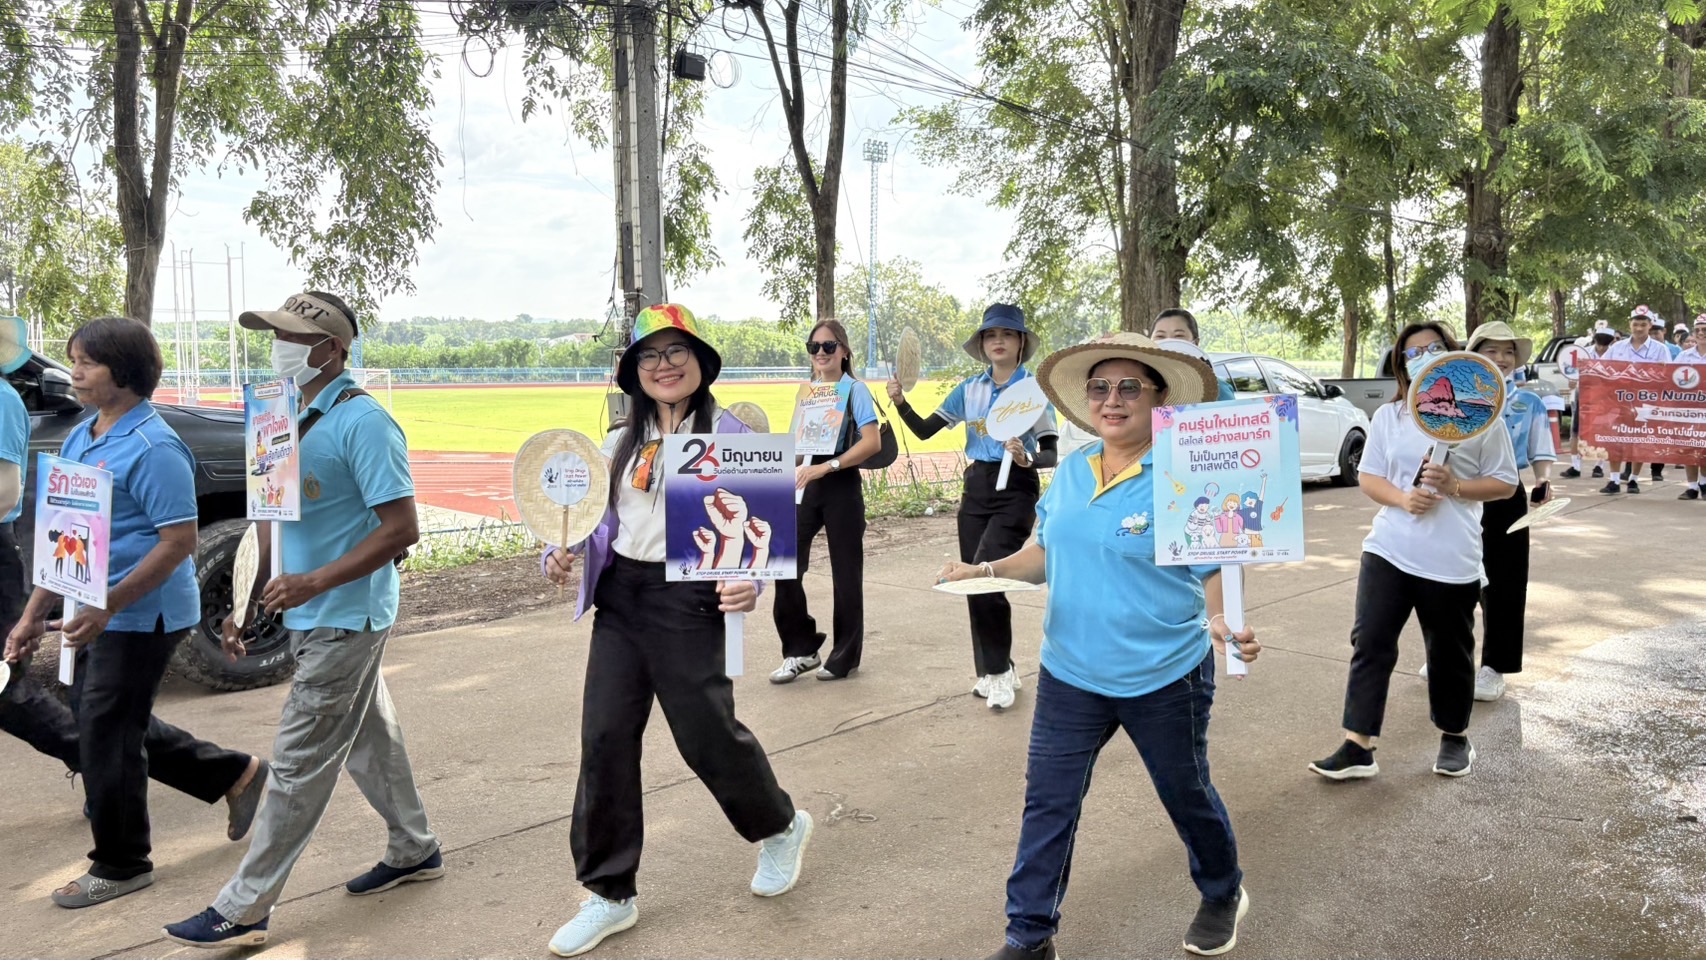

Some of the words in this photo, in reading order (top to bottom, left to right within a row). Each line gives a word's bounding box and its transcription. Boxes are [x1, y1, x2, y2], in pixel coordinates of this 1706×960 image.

[1681, 368, 1690, 382] 1
[1615, 389, 1635, 402] To
[1638, 389, 1658, 401] Be
[1178, 411, 1270, 433] คนรุ่นใหม่เทสดี
[1204, 429, 1271, 445] อย่างสมาร์ท
[677, 438, 721, 482] 26
[721, 448, 783, 467] มิถุนายน
[1189, 449, 1239, 462] ไม่เป็นทาส
[713, 466, 783, 475] วันต่อต้านยาเสพติดโลก
[1190, 460, 1238, 472] ยาเสพติด
[48, 466, 69, 495] รัก
[70, 472, 97, 489] ตัวเอง
